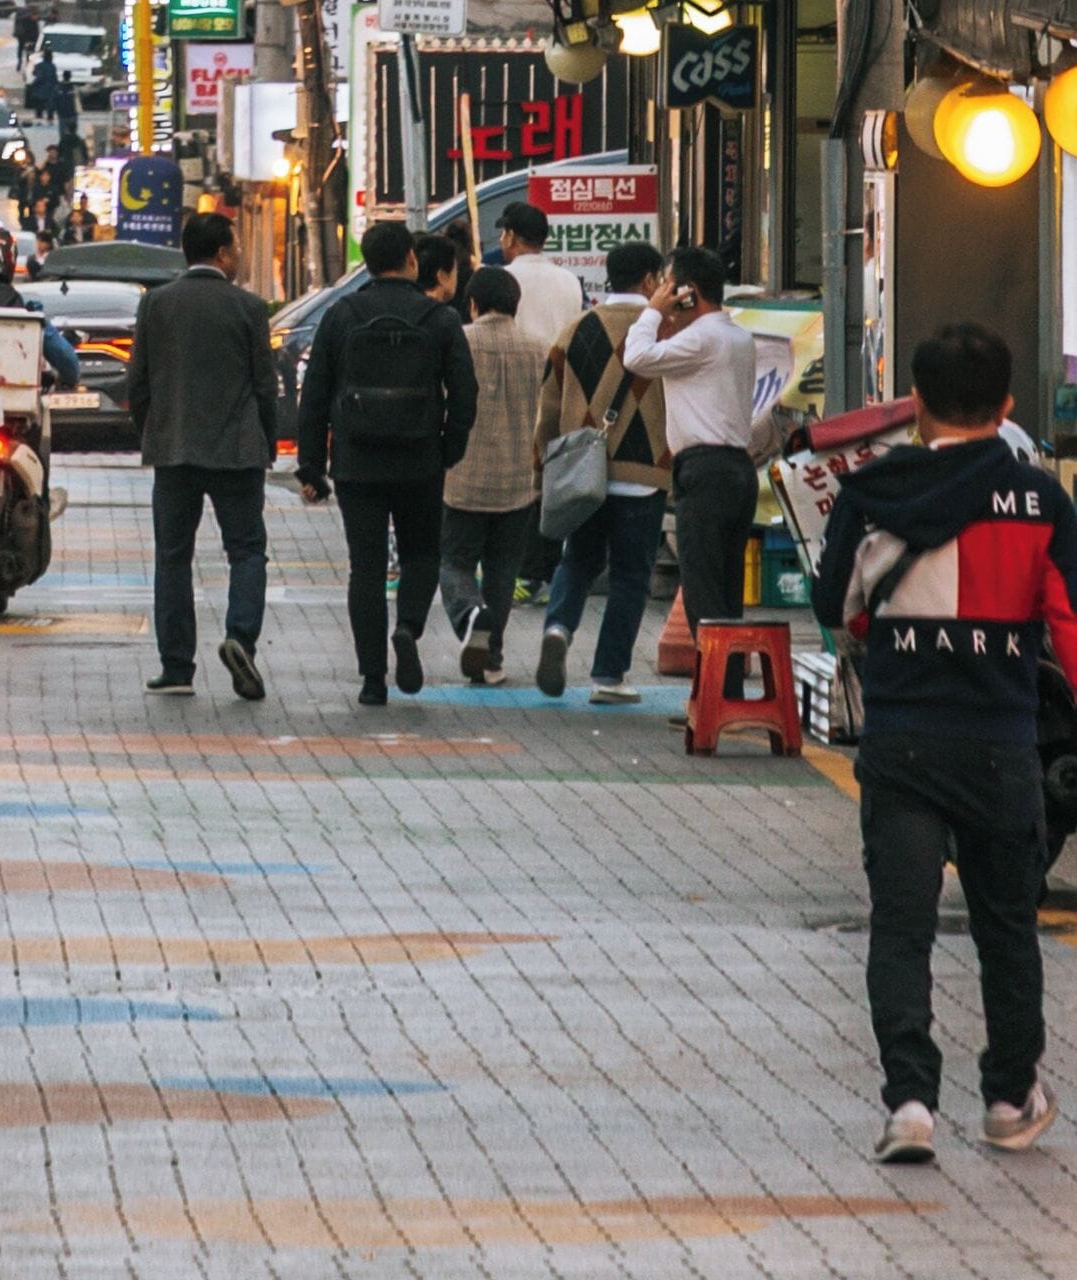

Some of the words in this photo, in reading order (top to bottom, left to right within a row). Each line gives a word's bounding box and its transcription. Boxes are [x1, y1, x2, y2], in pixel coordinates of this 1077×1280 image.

[446, 92, 584, 162] 노래
[549, 177, 637, 202] 점심특선
[992, 491, 1041, 516] ME
[894, 627, 1021, 656] MARK
